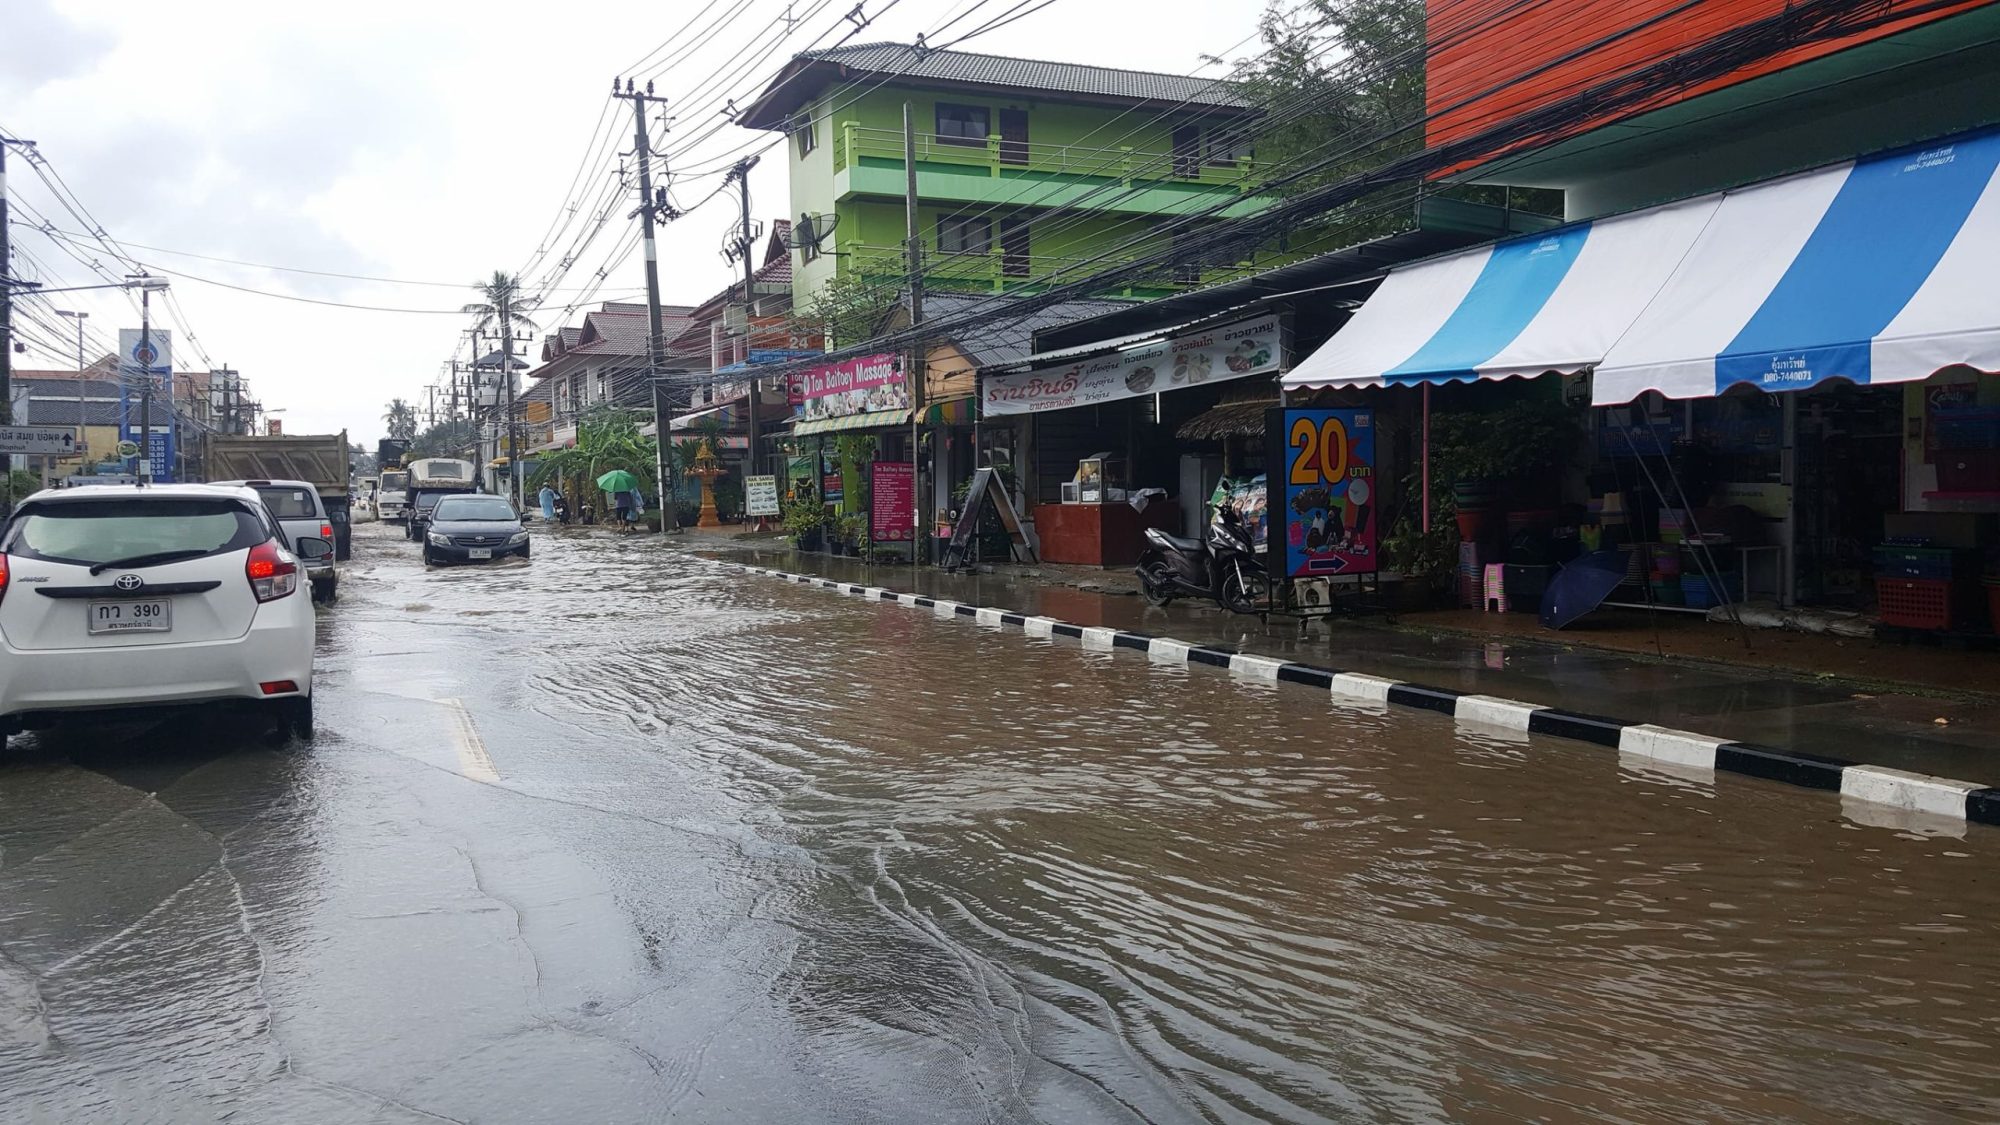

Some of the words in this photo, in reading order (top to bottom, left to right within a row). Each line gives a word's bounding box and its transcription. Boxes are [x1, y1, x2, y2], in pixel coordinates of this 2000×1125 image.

[1225, 322, 1274, 341] ข้าวขาหมู
[789, 337, 808, 349] 24
[1172, 333, 1214, 353] ข้าวมันไก่
[1771, 354, 1806, 372] คุ้มทรัพย์
[826, 369, 853, 389] Baitoey
[855, 362, 893, 384] Massage
[16, 432, 34, 444] สมุย
[37, 429, 60, 444] บ่อผุด
[1290, 416, 1347, 485] 20
[1350, 466, 1371, 477] บาท
[99, 606, 121, 619] กว
[134, 604, 160, 617] 390
